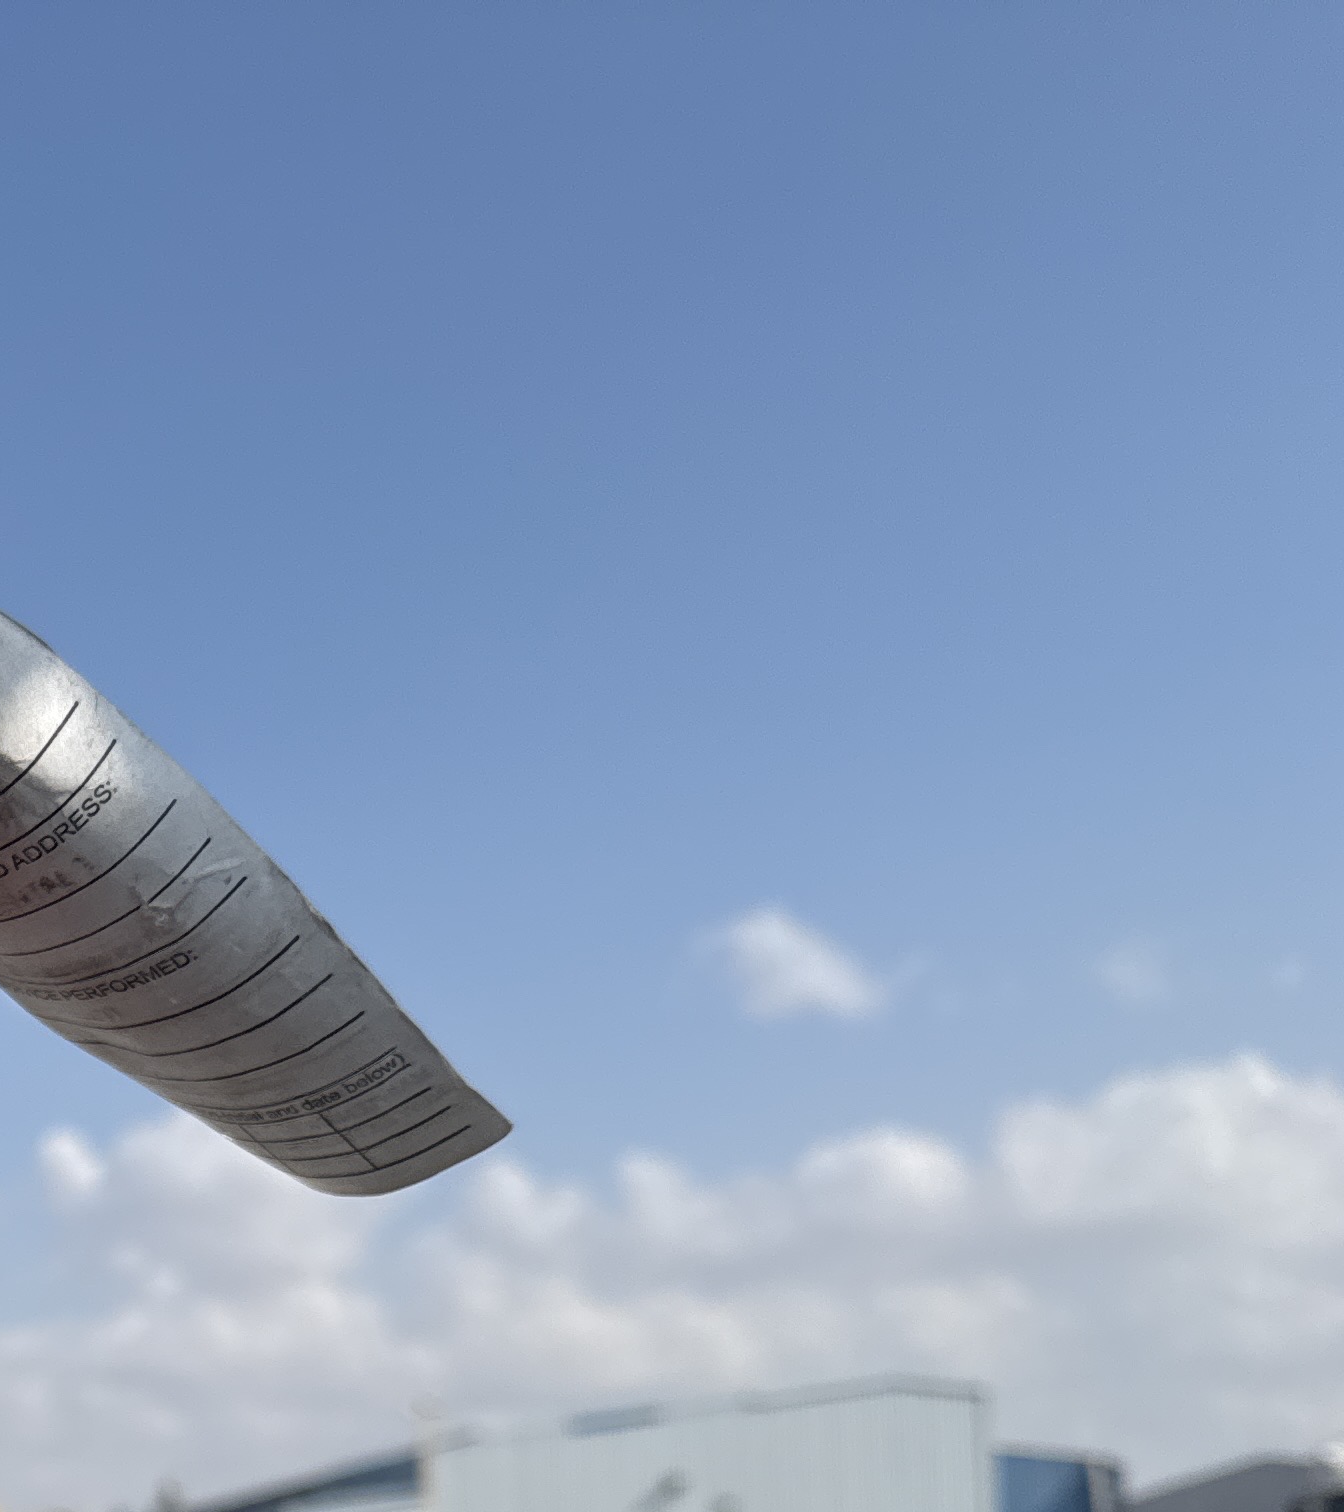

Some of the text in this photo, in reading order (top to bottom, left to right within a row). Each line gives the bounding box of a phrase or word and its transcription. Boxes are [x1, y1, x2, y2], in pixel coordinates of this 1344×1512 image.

[12, 779, 117, 871] ADDRESS:
[62, 949, 198, 1001] PERFORMED:
[344, 1053, 405, 1093] below)
